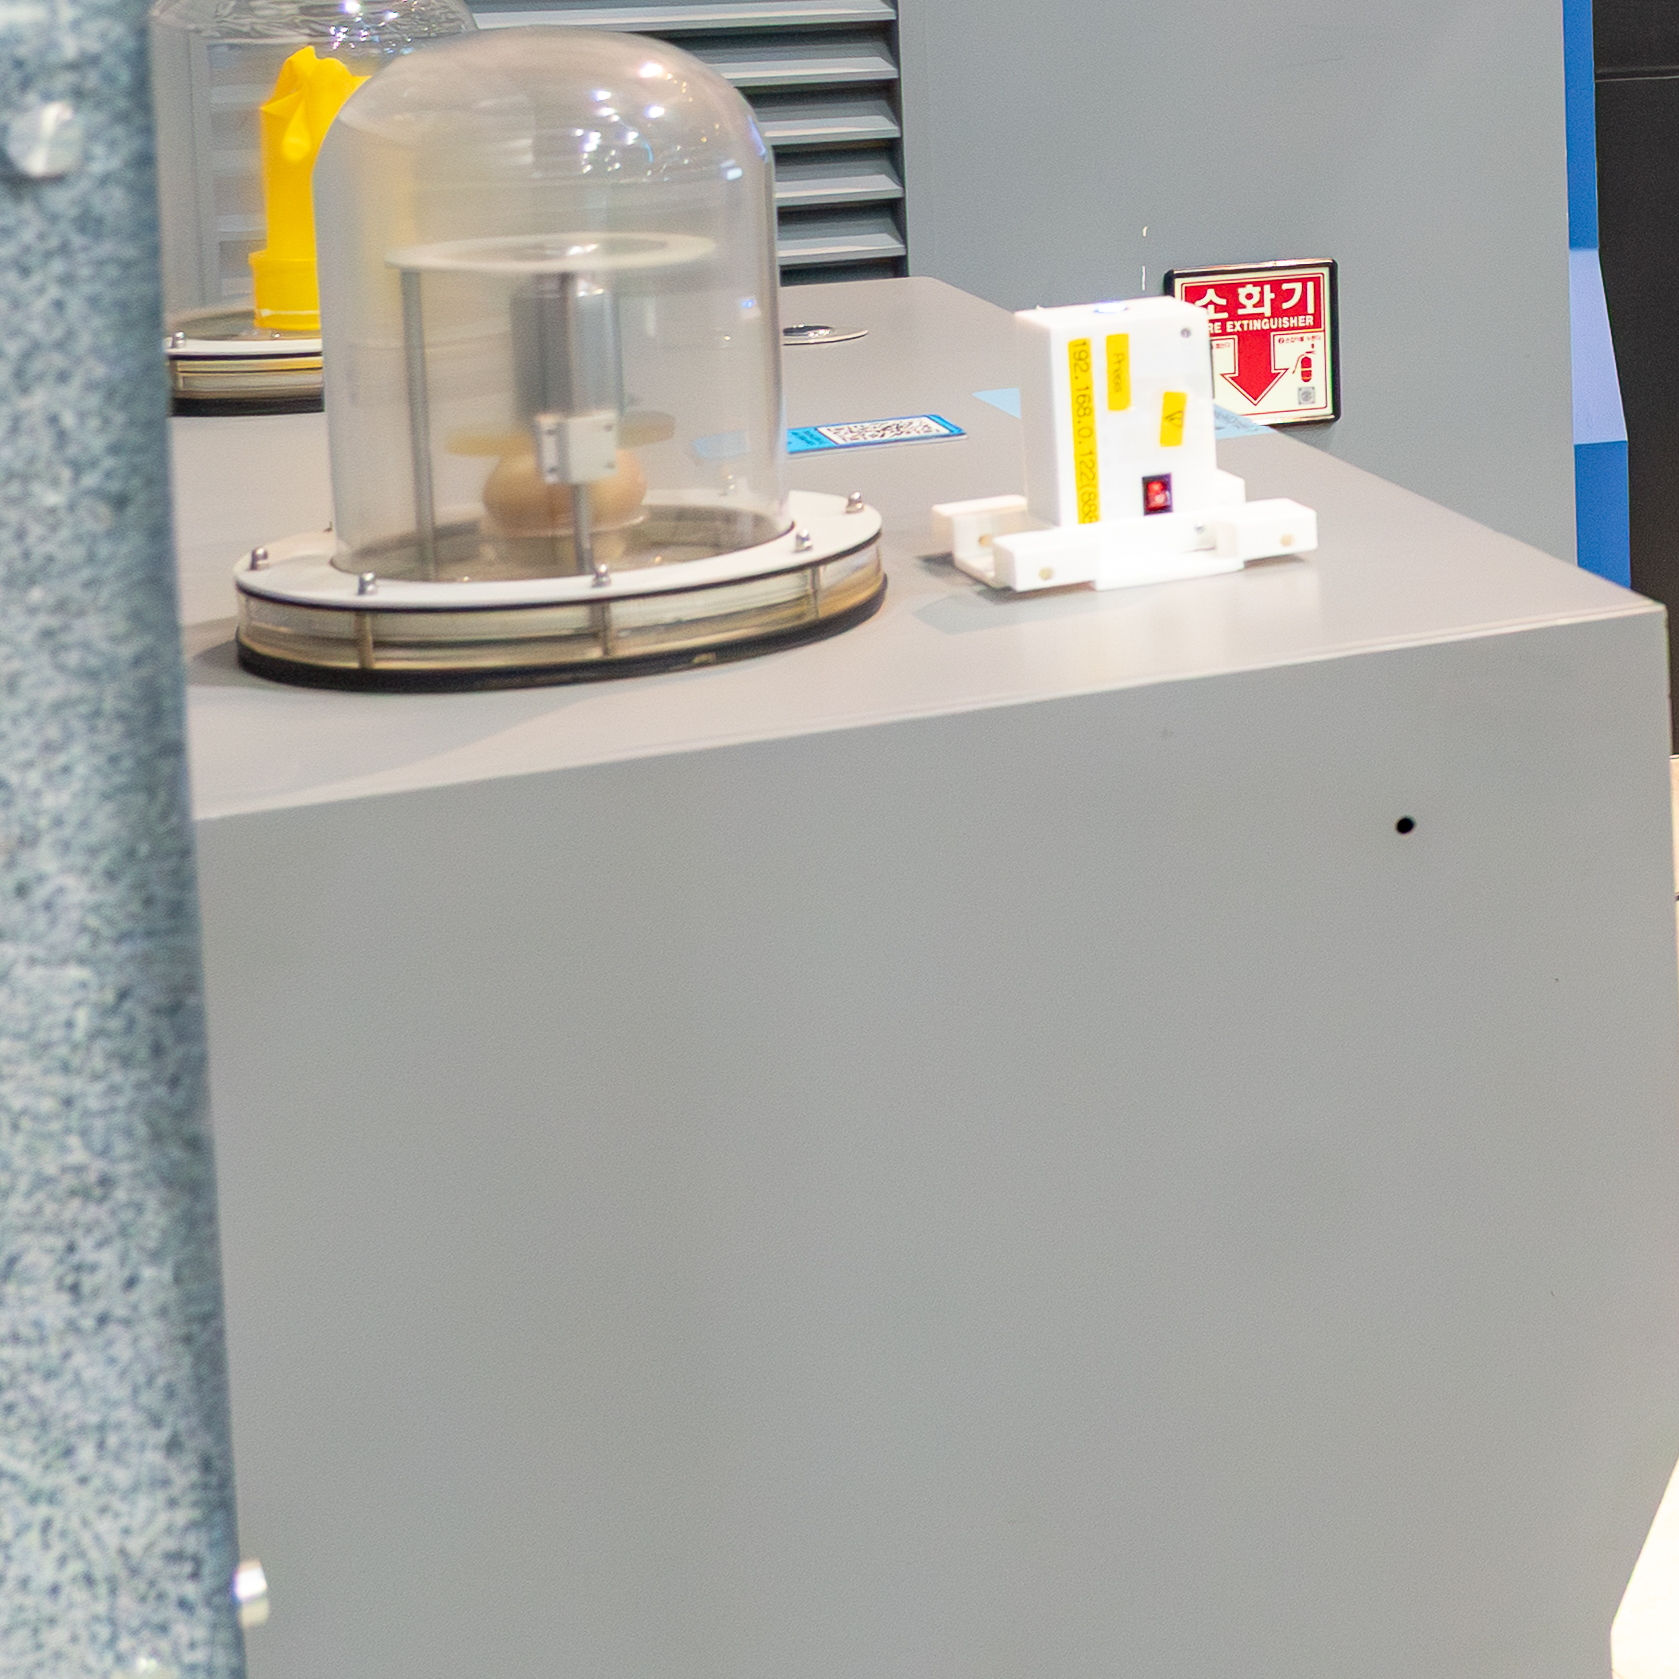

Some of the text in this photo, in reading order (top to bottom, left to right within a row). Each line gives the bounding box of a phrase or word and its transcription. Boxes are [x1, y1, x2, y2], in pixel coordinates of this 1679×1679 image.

[1195, 281, 1314, 319] 소화기
[1209, 315, 1314, 334] RE EXTINGUISHER
